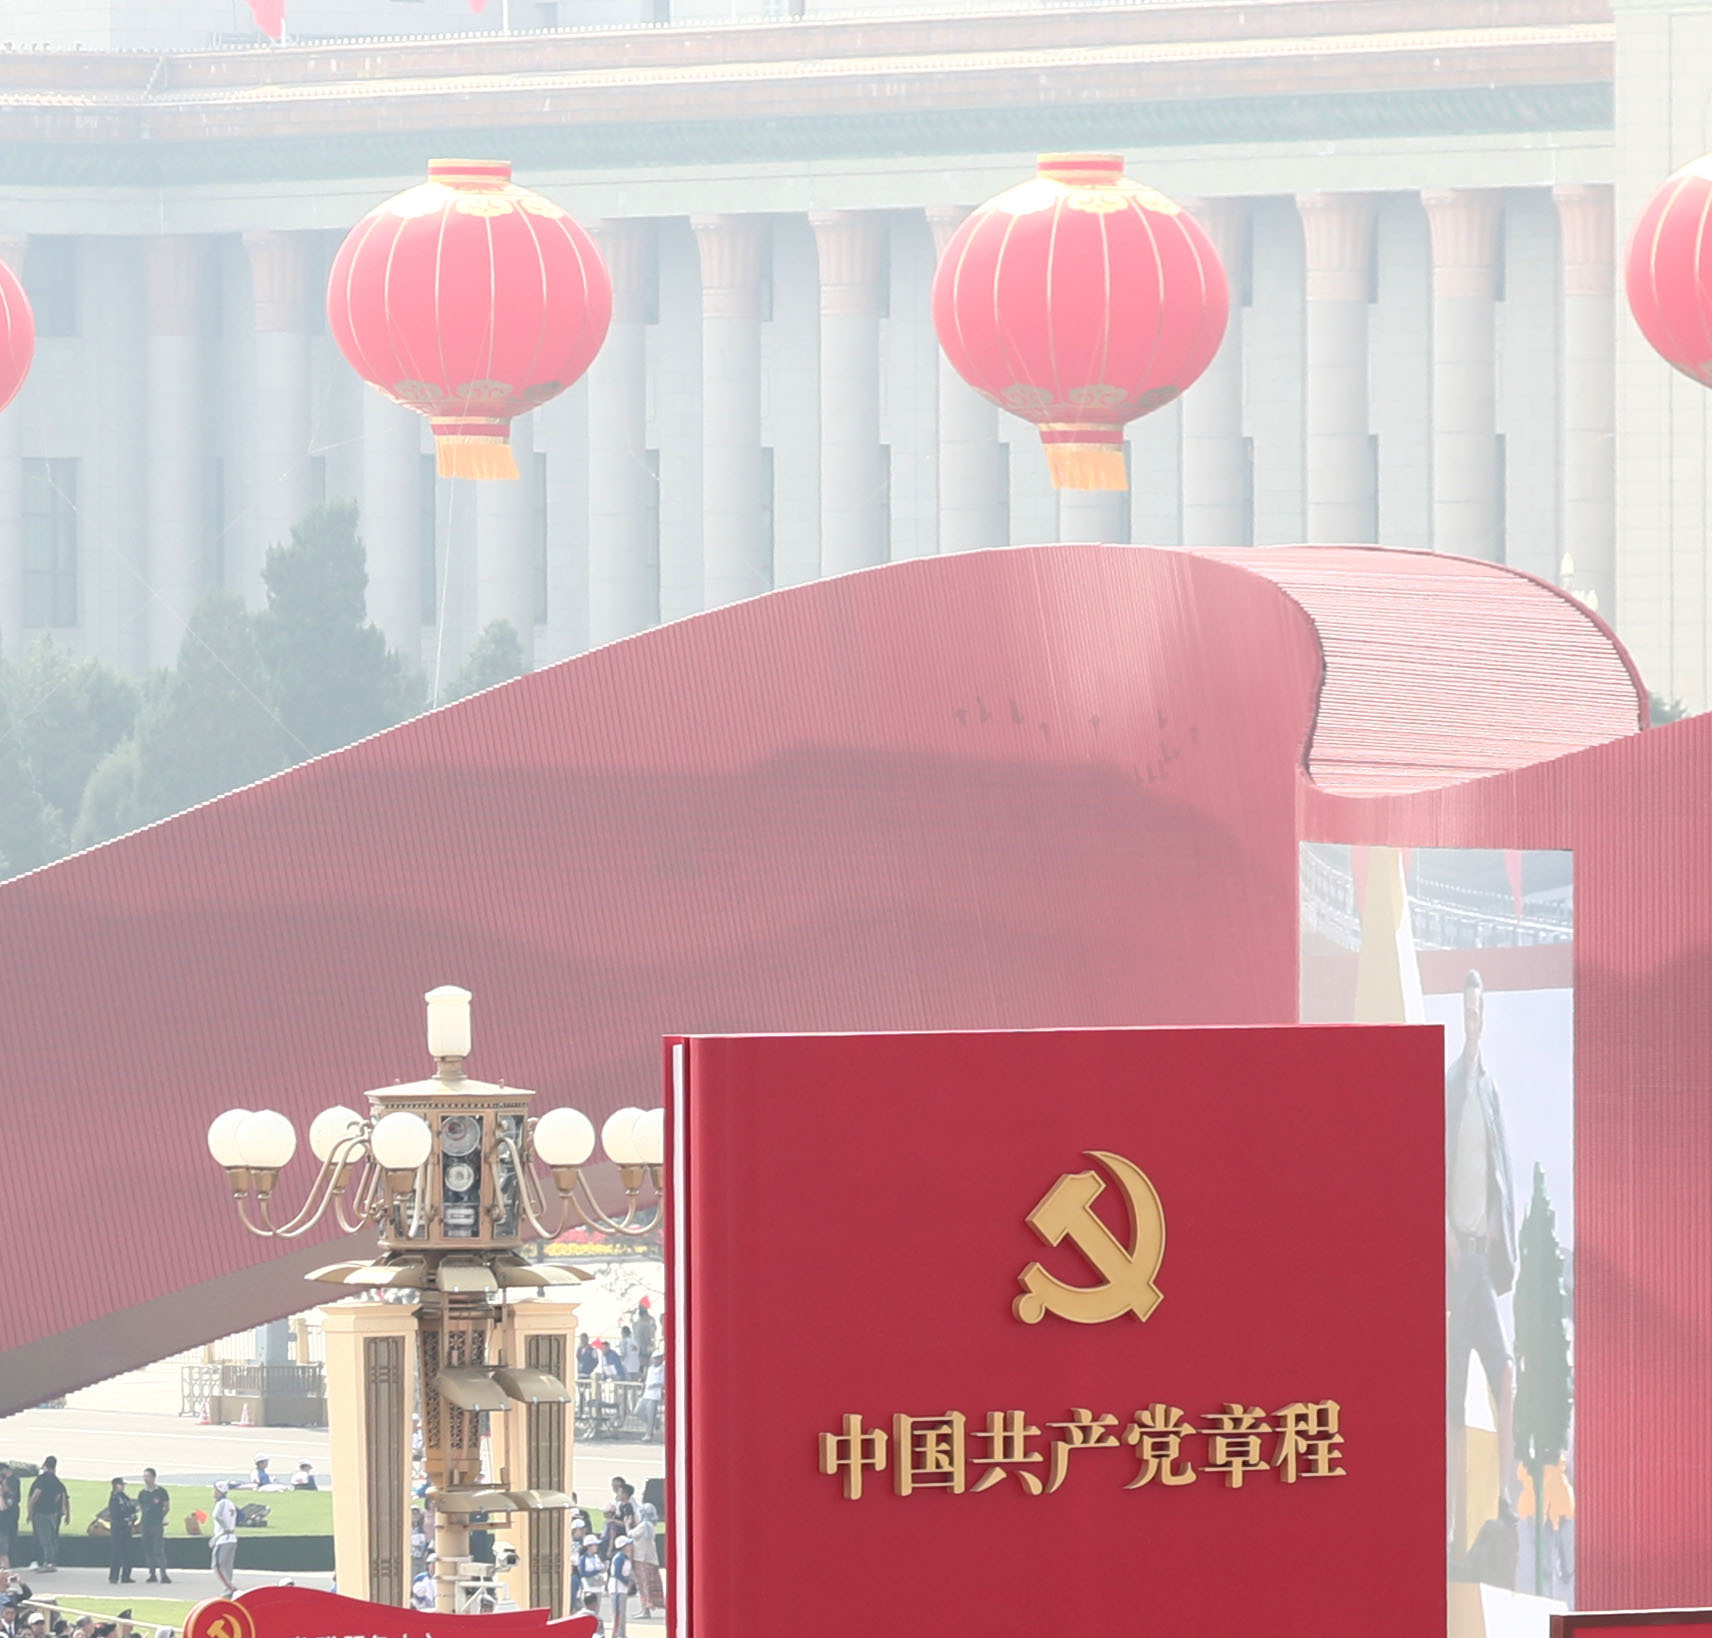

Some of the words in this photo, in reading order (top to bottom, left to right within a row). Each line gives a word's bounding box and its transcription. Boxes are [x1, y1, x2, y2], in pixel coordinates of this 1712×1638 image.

[818, 1399, 1348, 1501] 中国共产党章程
